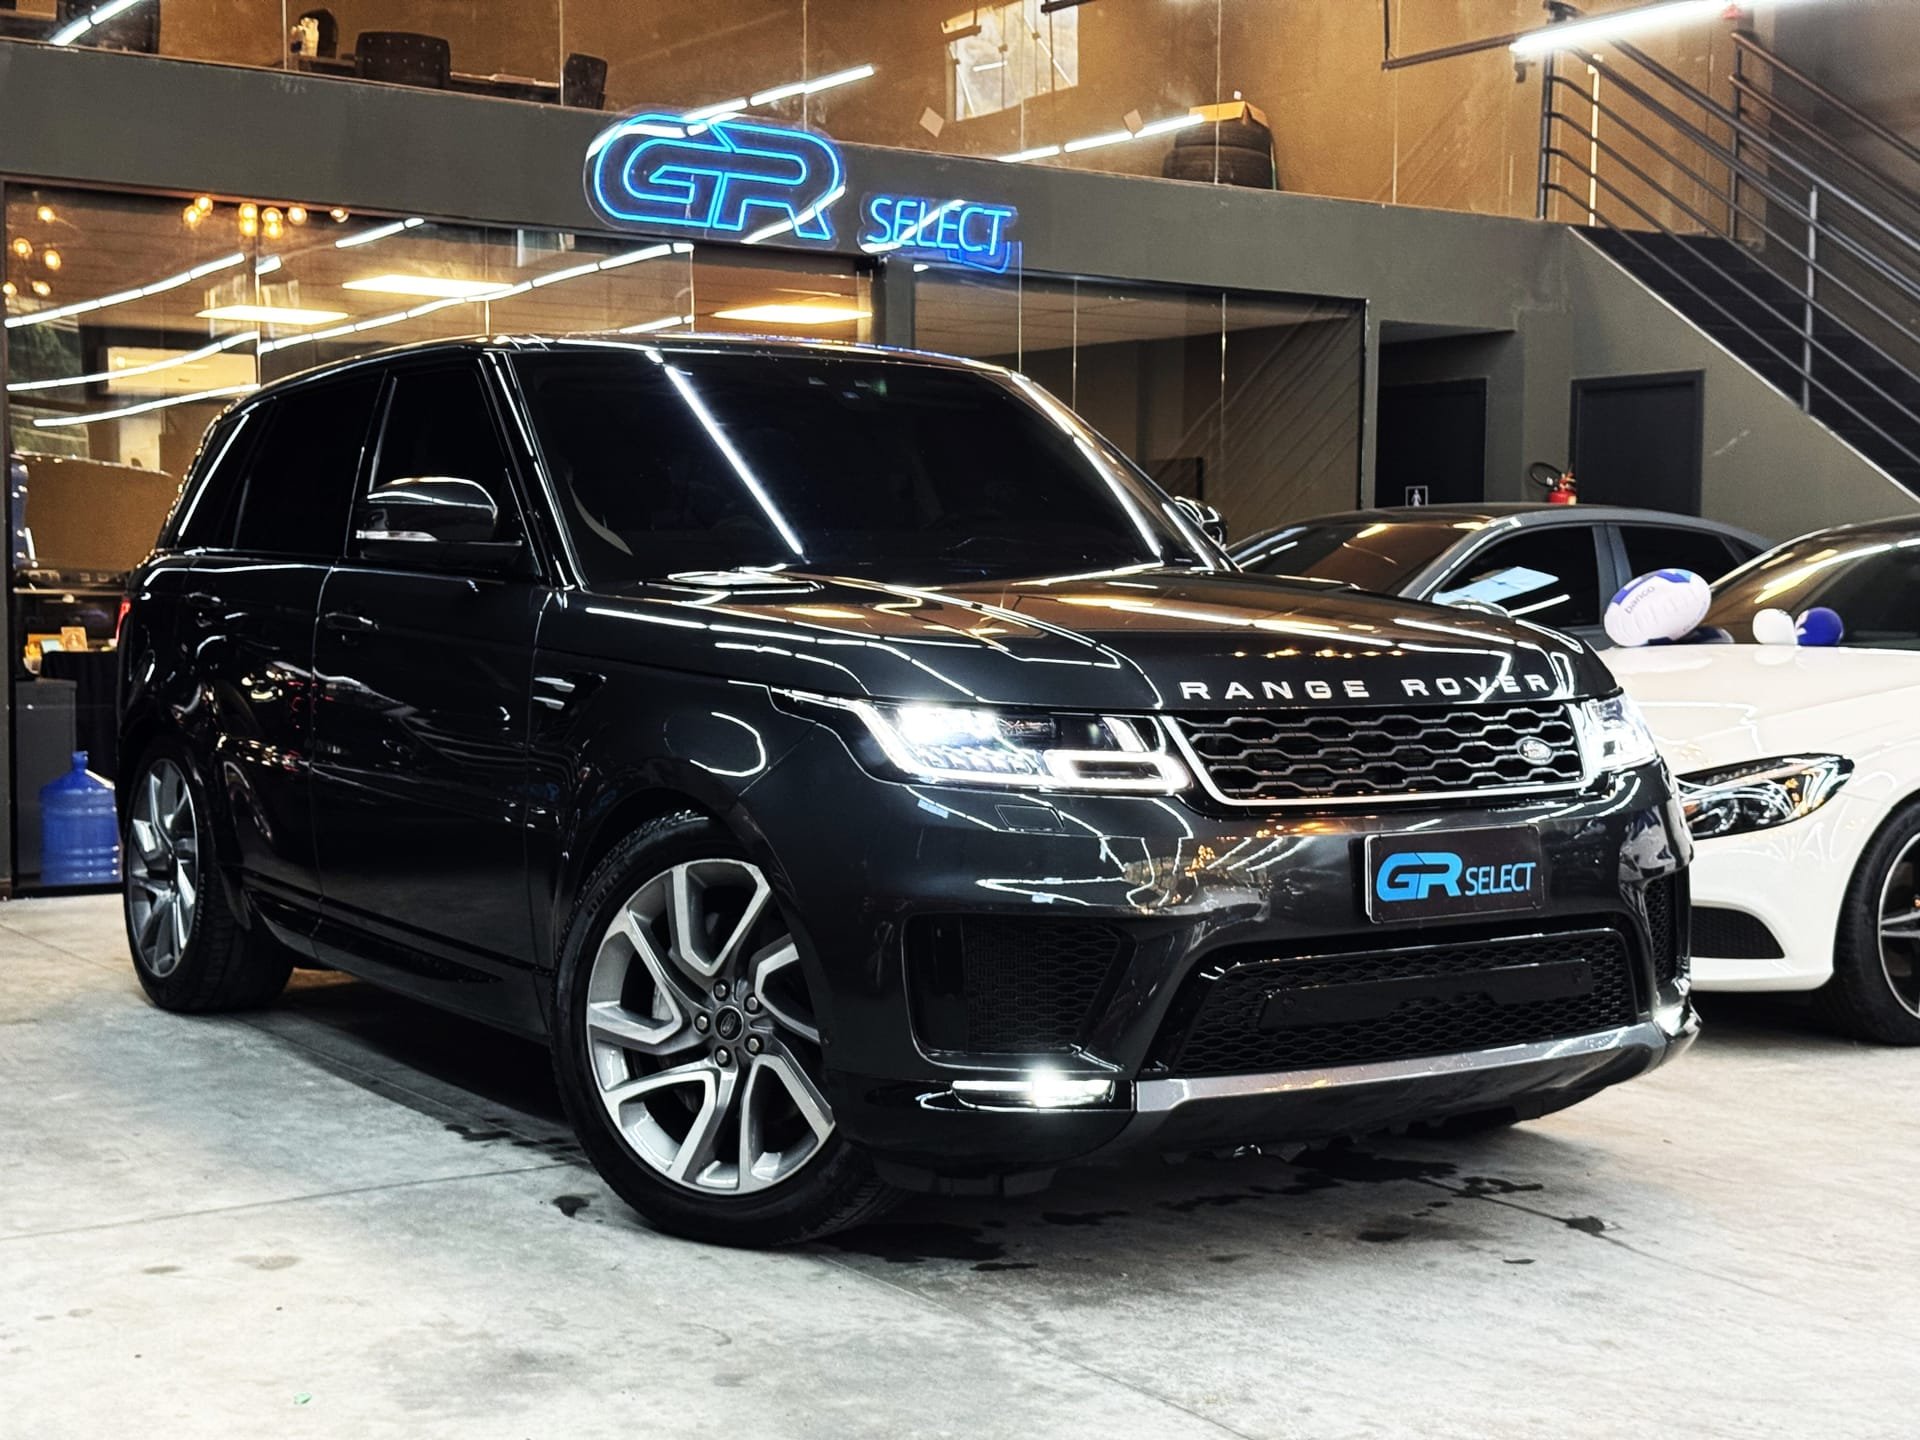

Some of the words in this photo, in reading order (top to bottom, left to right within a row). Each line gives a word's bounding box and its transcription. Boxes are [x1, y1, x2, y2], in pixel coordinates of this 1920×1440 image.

[593, 112, 841, 240] GR
[866, 198, 1012, 256] SELECT
[1179, 680, 1370, 700] RANGE
[1401, 674, 1550, 698] ROVER
[1376, 852, 1463, 902] GR
[1465, 862, 1537, 896] SELECT
